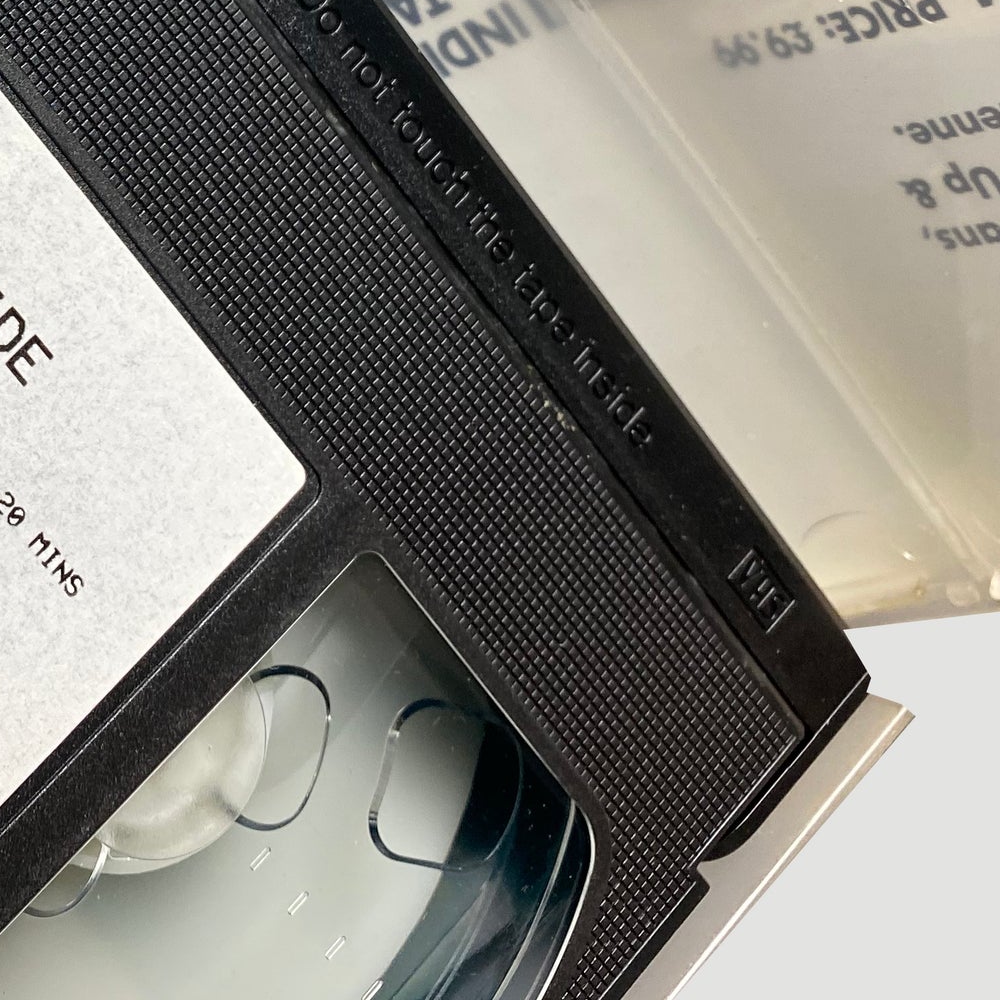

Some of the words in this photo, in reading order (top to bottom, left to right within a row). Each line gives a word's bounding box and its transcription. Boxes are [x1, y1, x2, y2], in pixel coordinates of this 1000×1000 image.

[898, 177, 937, 209] &
[340, 39, 397, 105] not
[391, 101, 471, 209] touch
[468, 195, 515, 265] the
[512, 261, 576, 346] tape
[573, 337, 653, 450] inside
[26, 530, 86, 599] MINS
